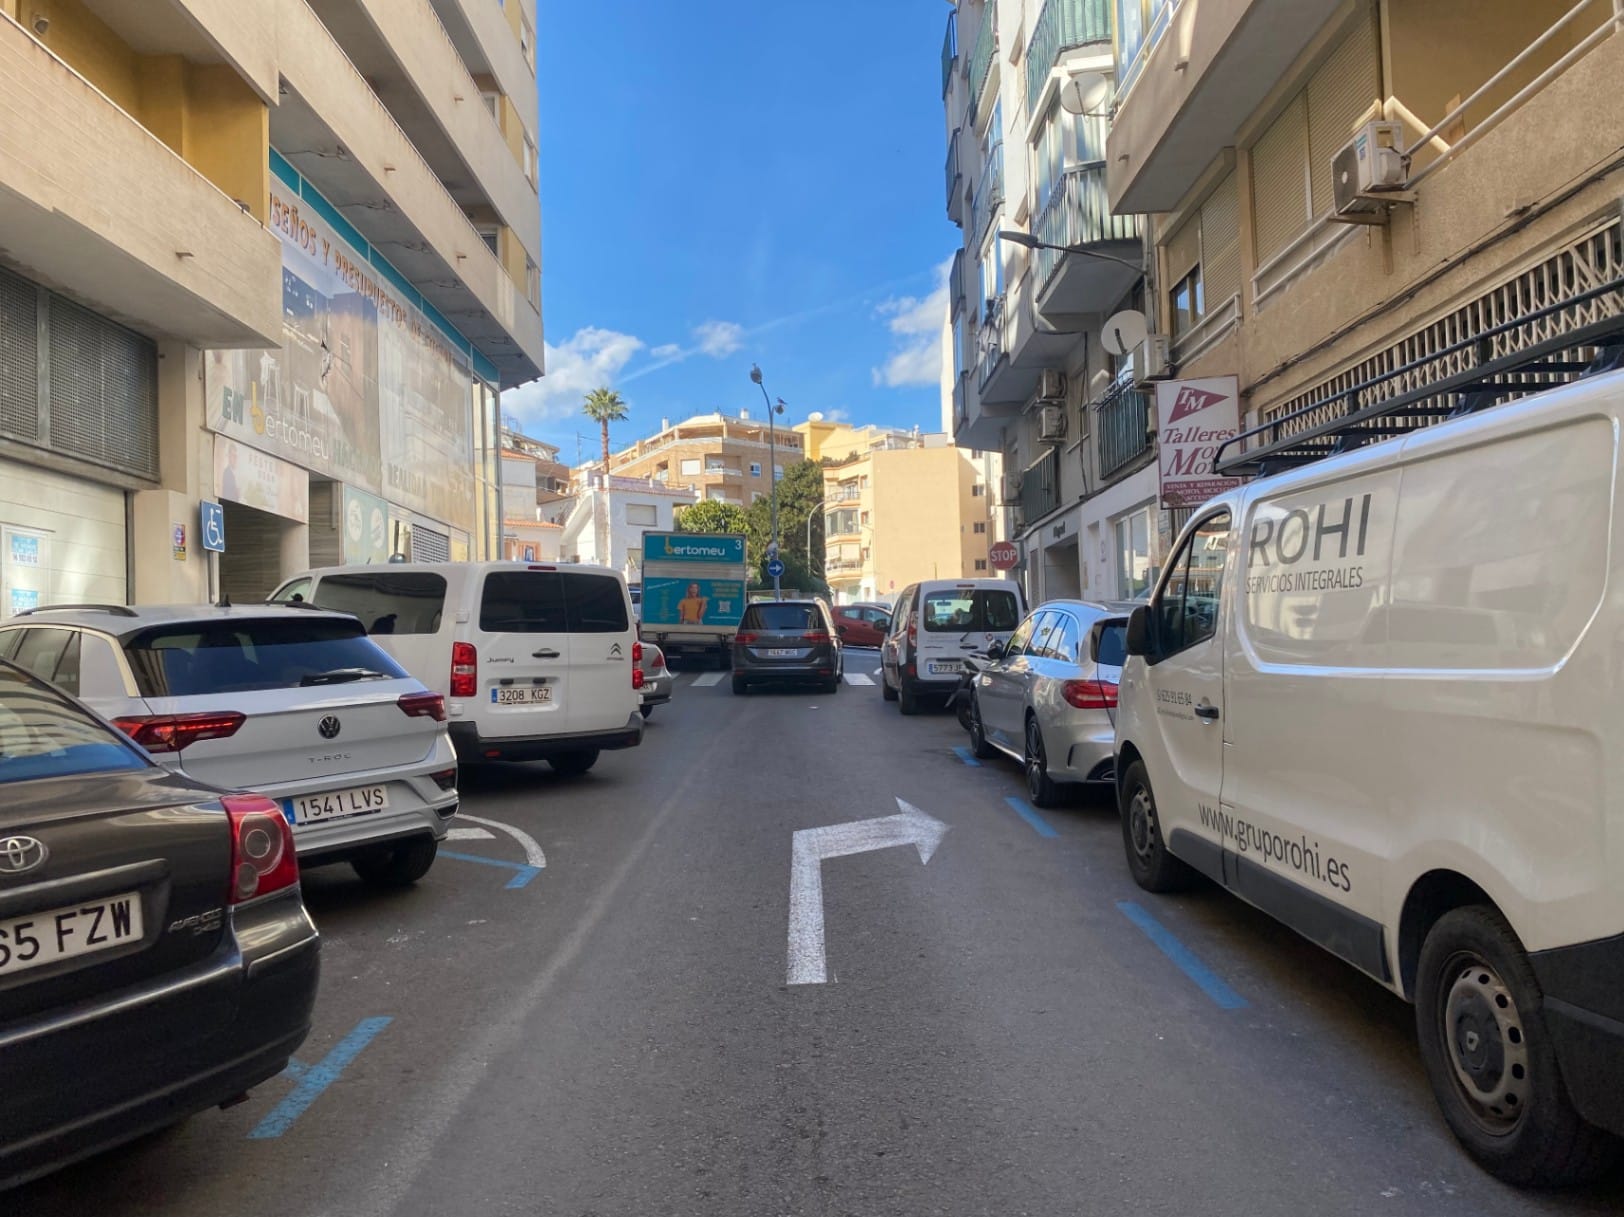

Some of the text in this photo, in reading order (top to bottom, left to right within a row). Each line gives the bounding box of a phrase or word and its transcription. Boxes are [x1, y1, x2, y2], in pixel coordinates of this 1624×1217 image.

[269, 192, 316, 256] ISEÑOS
[323, 239, 330, 266] Y
[1178, 388, 1208, 411] TM
[222, 381, 329, 460] EN bertomeu
[1163, 426, 1237, 444] Talleres
[735, 539, 742, 550] 3
[1248, 494, 1372, 568] ROHI
[664, 535, 726, 556] bertomeu
[990, 550, 1017, 562] STOP
[1246, 567, 1363, 594] SERVICIOS INTEGRALES
[500, 688, 550, 701] 3208 KGZ
[300, 794, 344, 818] 1541
[350, 788, 384, 810] LVS
[1198, 803, 1351, 892] www.gruporohi.es
[54, 900, 131, 952] FZW
